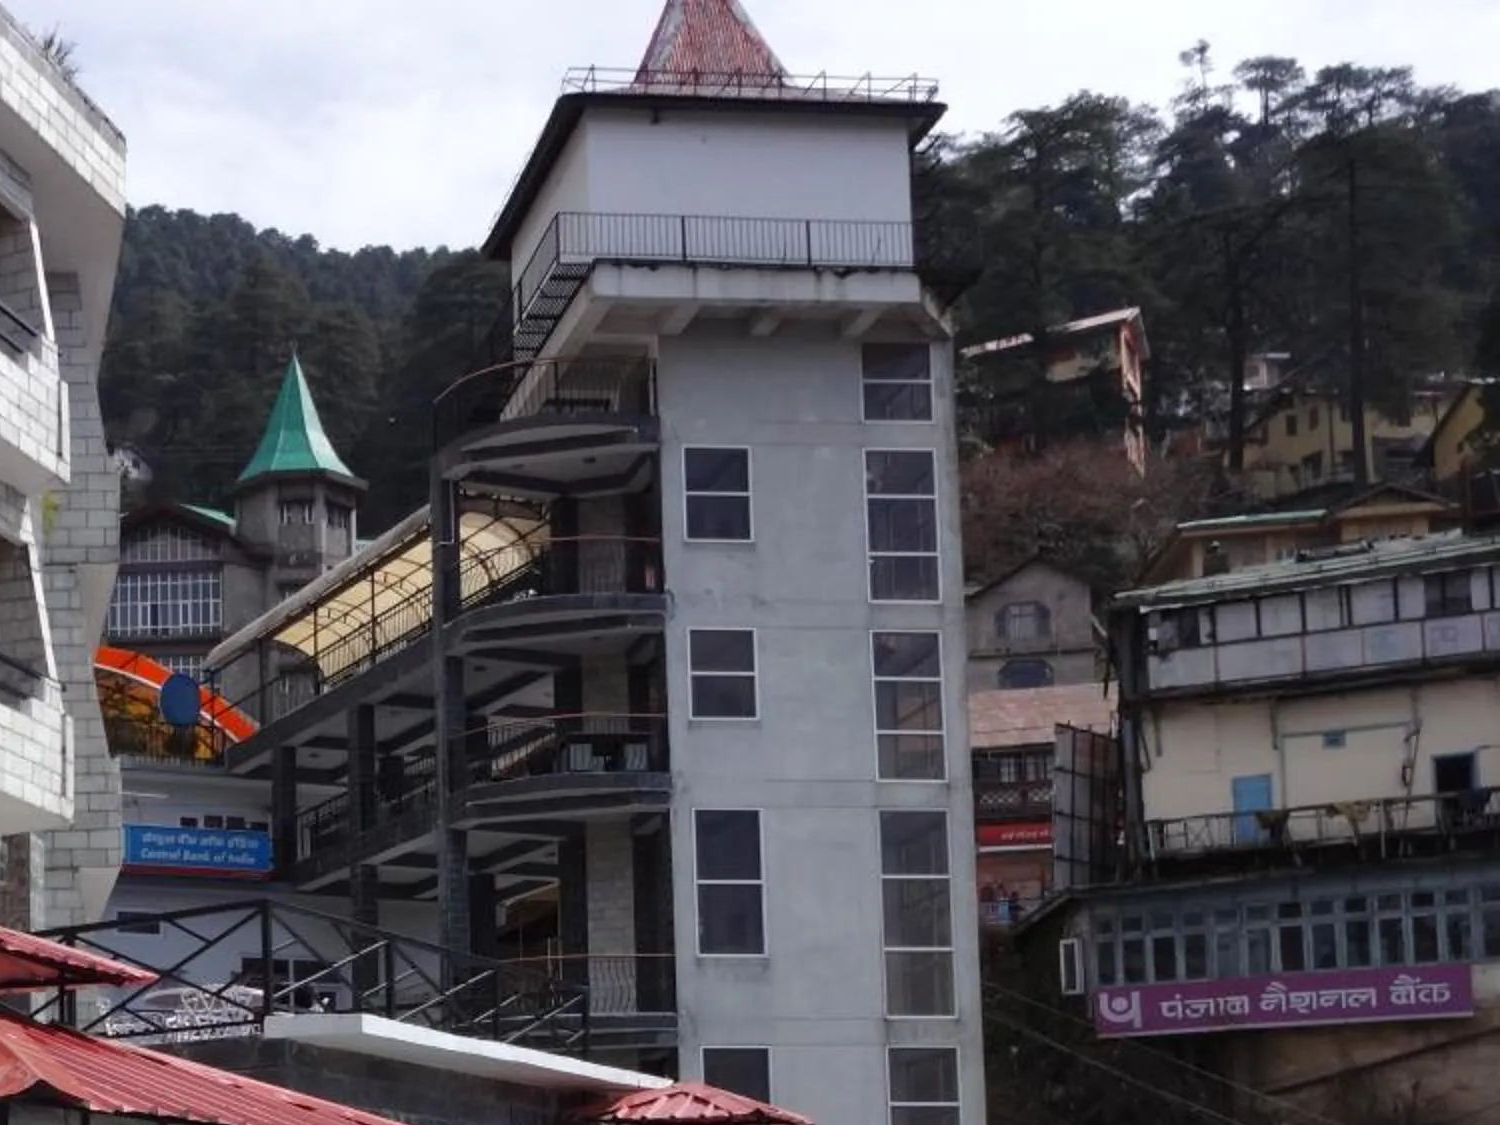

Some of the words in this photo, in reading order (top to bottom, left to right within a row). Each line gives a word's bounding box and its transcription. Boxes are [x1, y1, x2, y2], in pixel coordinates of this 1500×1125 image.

[141, 847, 181, 859] Central
[183, 849, 210, 861] Bank
[1159, 993, 1249, 1020] पंजाब
[1389, 974, 1451, 1005] बैंक
